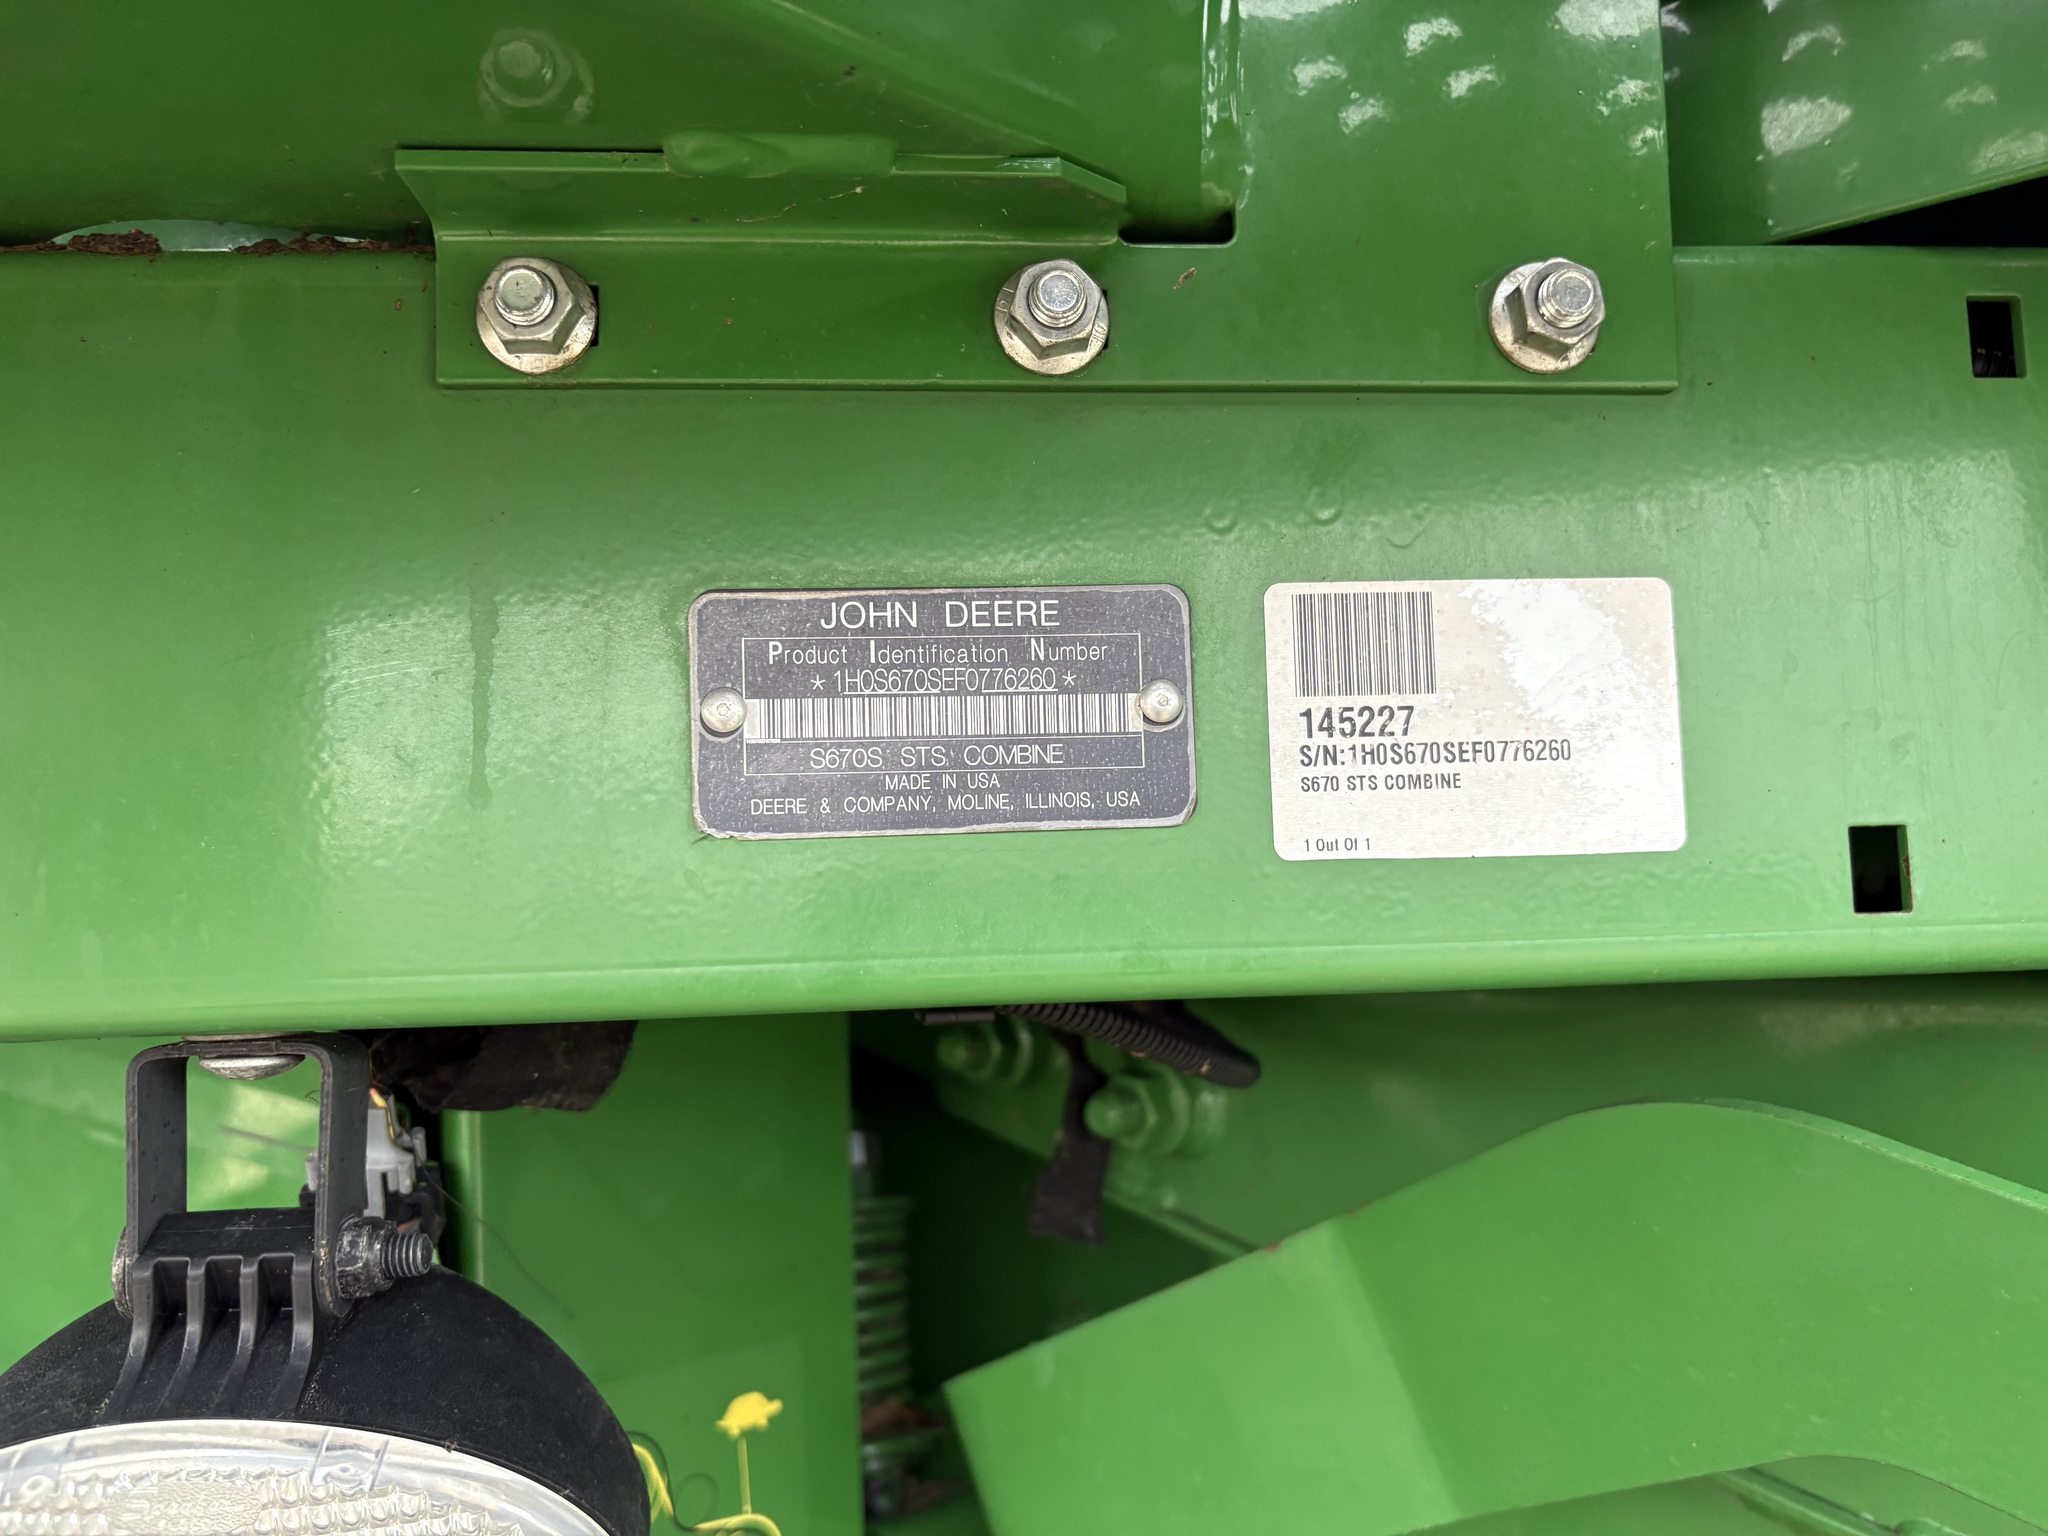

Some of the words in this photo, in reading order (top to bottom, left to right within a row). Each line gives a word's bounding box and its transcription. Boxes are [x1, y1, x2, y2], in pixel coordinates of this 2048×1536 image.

[820, 601, 918, 629] JOHN
[944, 600, 1061, 628] DEERE
[768, 641, 849, 665] Product
[869, 640, 1009, 664] Identification
[1030, 637, 1108, 661] Number
[1299, 705, 1415, 739] 145227
[809, 748, 884, 769] S670S
[900, 746, 947, 767] STS
[963, 744, 1064, 766] COMBINE
[885, 774, 931, 790] MADE
[942, 774, 957, 789] IN
[967, 773, 1001, 789] USA
[1300, 775, 1340, 793] S670
[1347, 774, 1378, 791] STS
[1384, 772, 1462, 790] COMBINE
[751, 798, 807, 815] DEERE
[819, 798, 831, 814] &
[843, 795, 936, 813] COMPANY,
[947, 793, 1014, 811] MOLINE,
[1025, 791, 1095, 809] ILLINOIS,
[1106, 791, 1141, 807] USA
[1303, 838, 1310, 851] 1
[1316, 838, 1339, 851] Out
[1364, 837, 1371, 850] 1
